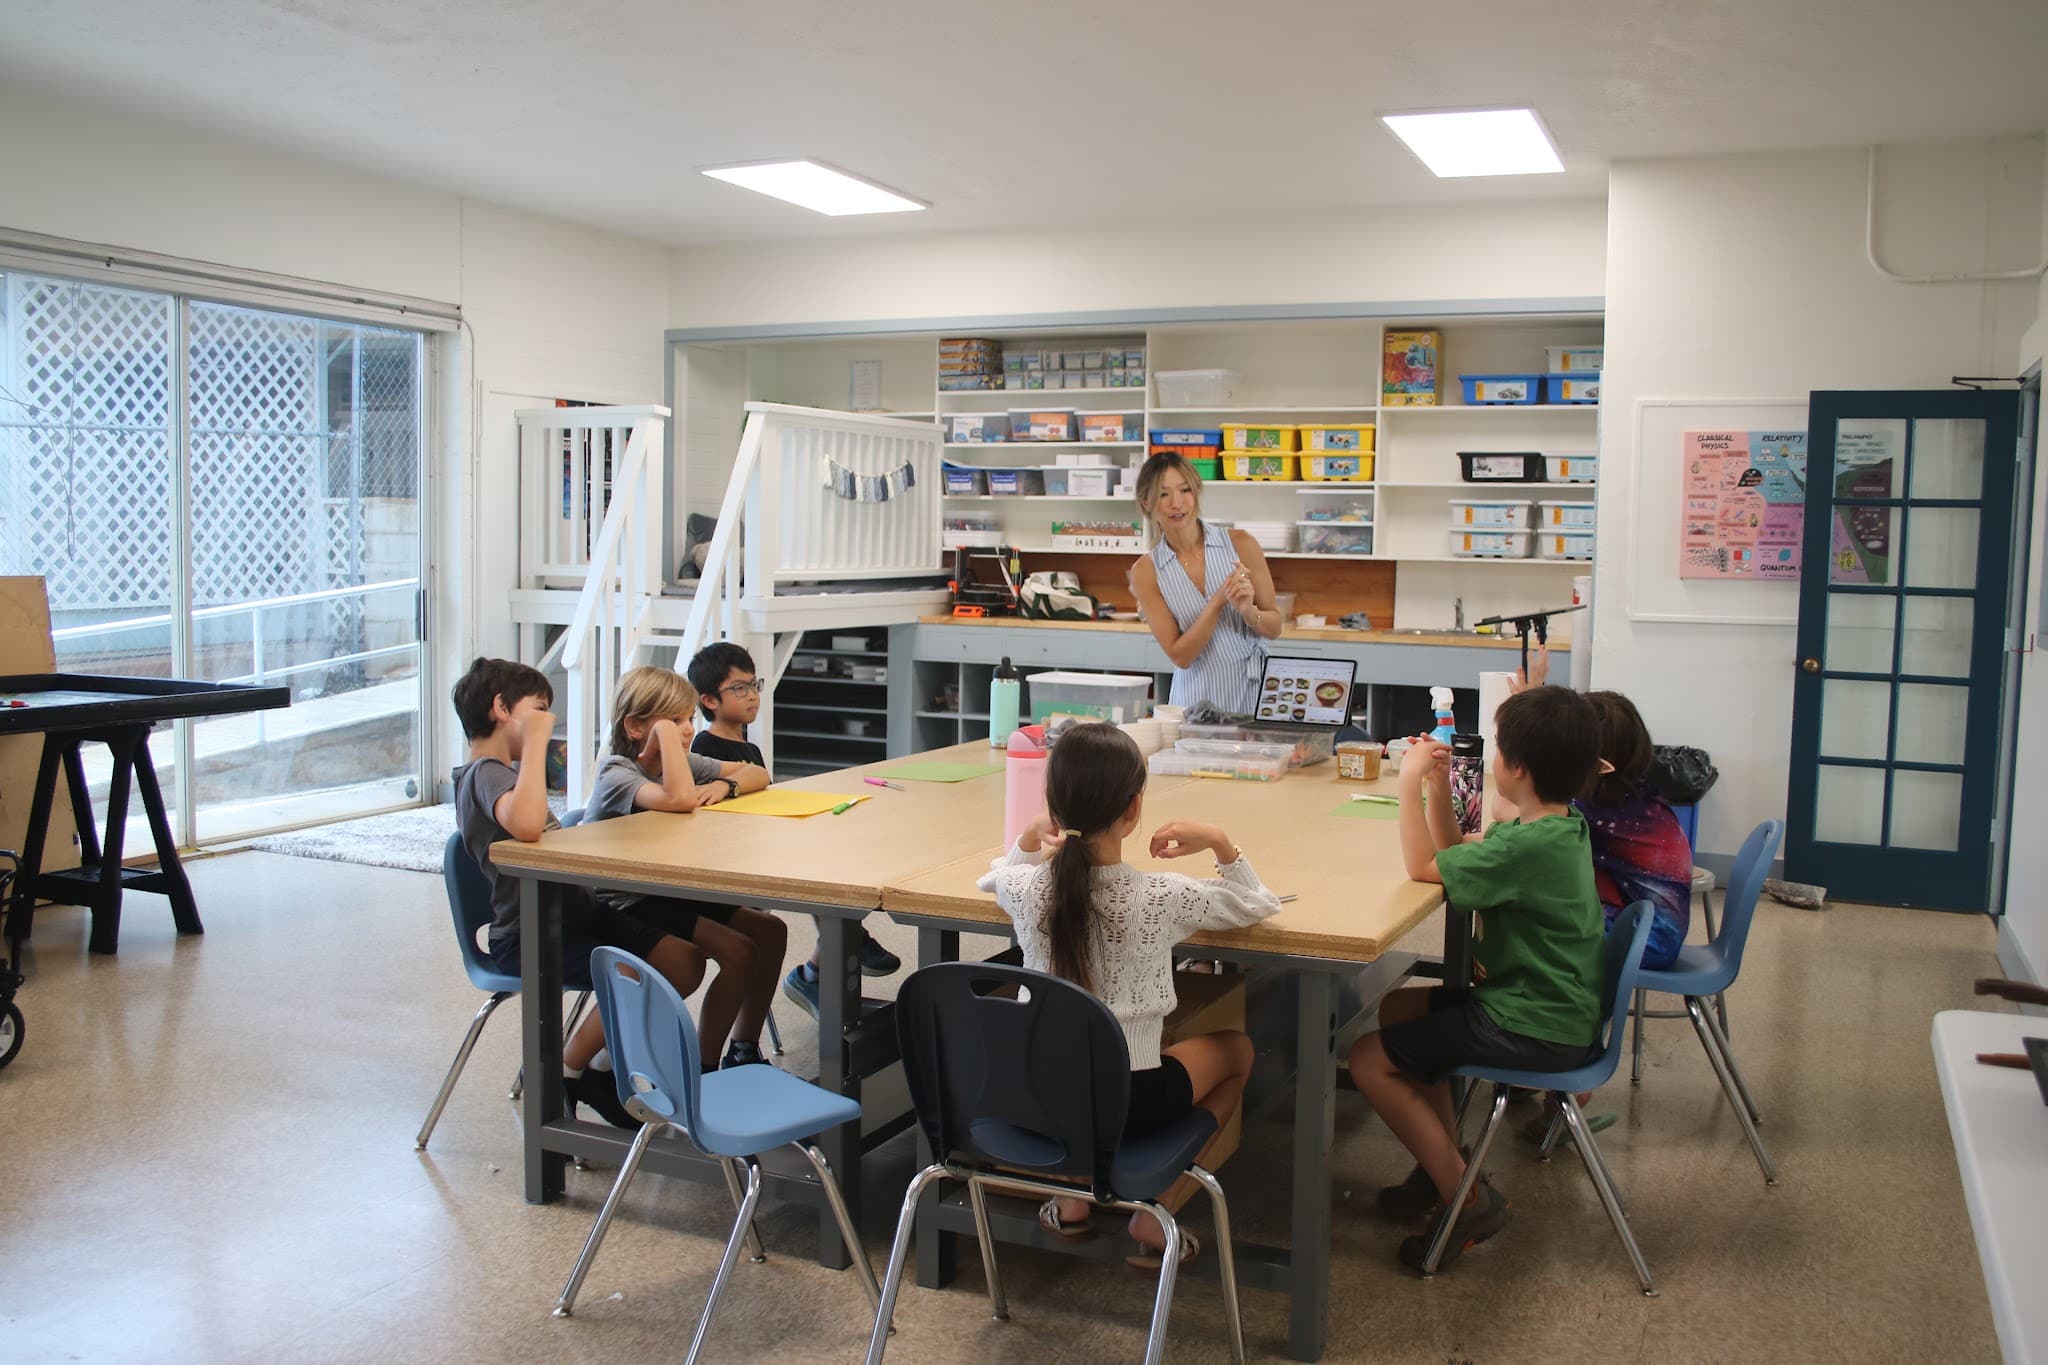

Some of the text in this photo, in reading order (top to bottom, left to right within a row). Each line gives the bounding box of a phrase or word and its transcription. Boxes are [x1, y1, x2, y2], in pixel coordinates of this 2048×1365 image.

[1697, 434, 1734, 442] CLASSICAL
[1762, 434, 1804, 443] RELATIVITY
[1701, 442, 1729, 450] PHYSICS
[1760, 564, 1796, 572] QUANTUM
